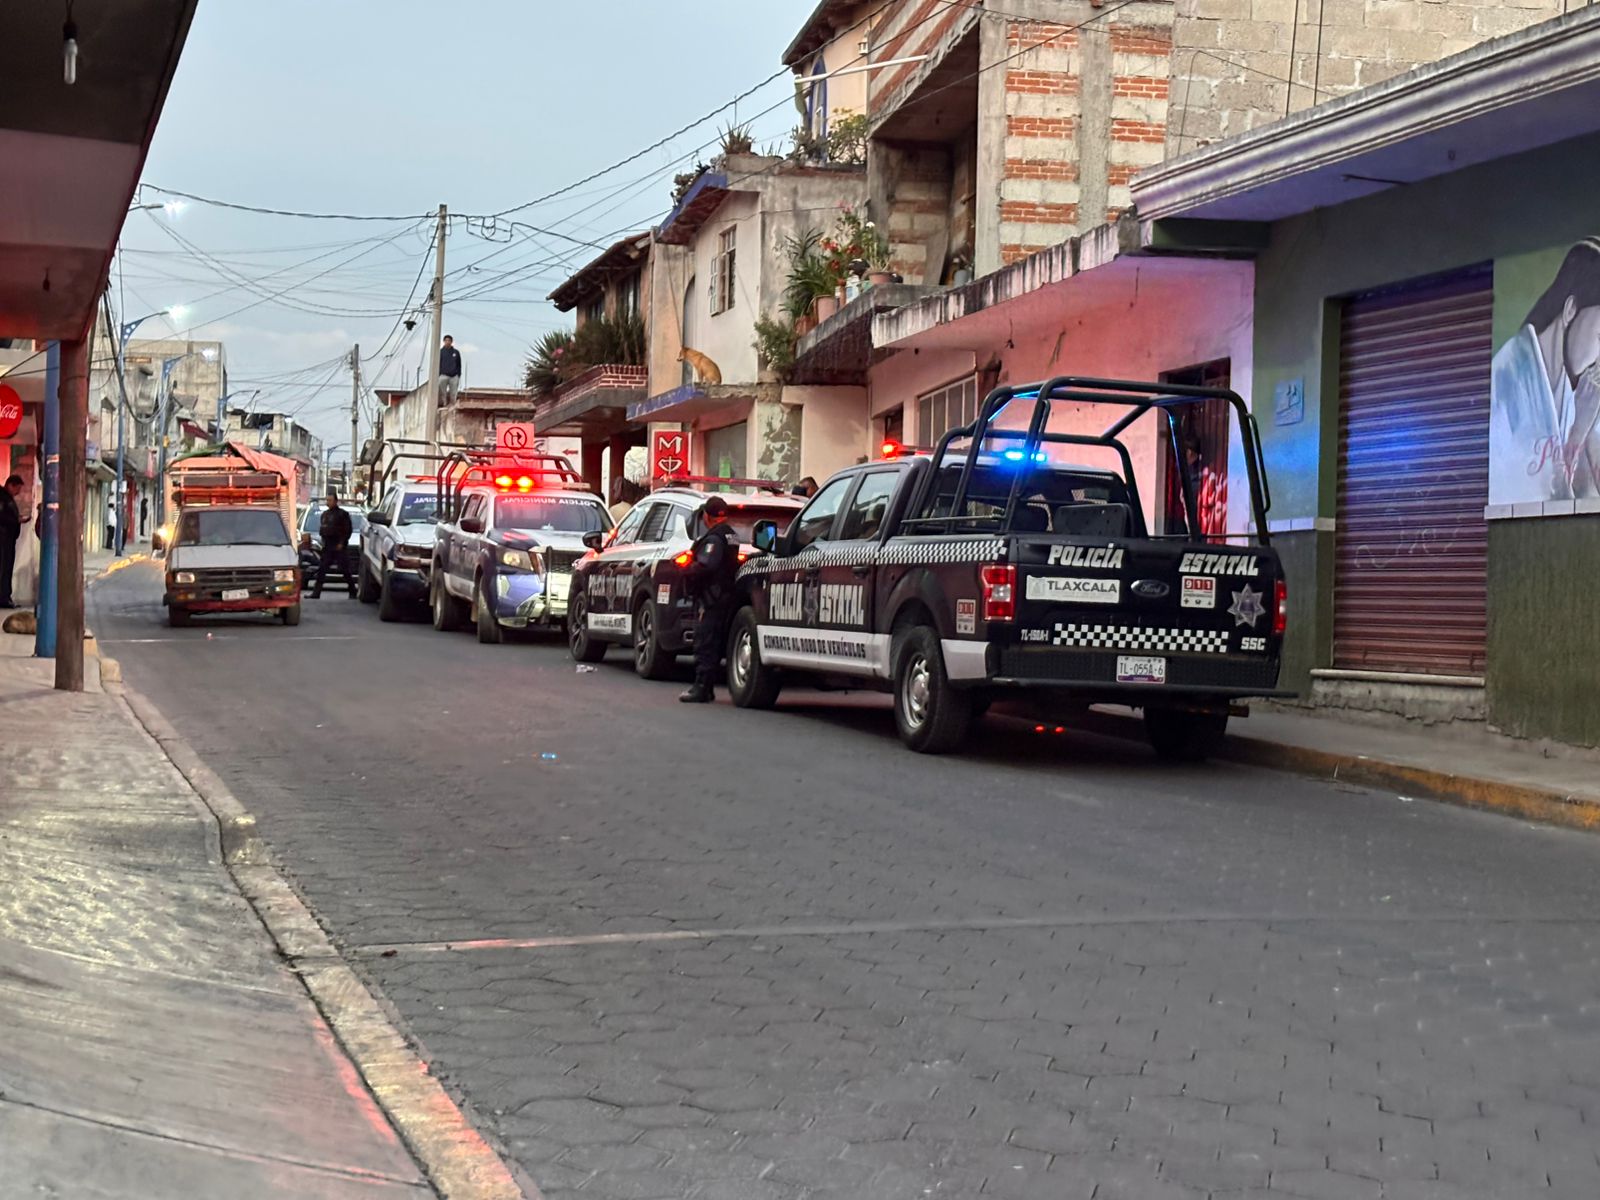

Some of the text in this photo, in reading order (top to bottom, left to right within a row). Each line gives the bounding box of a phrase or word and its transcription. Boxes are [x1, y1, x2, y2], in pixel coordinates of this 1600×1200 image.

[1047, 543, 1259, 576] POLICÍA ESTATAL
[1046, 579, 1118, 594] TLAXCALA
[1185, 579, 1212, 590] 911
[819, 584, 864, 625] ESTATAL
[763, 634, 791, 651] COMBATE
[792, 637, 800, 652] AL
[817, 639, 827, 655] DE
[1240, 637, 1266, 650] SSC
